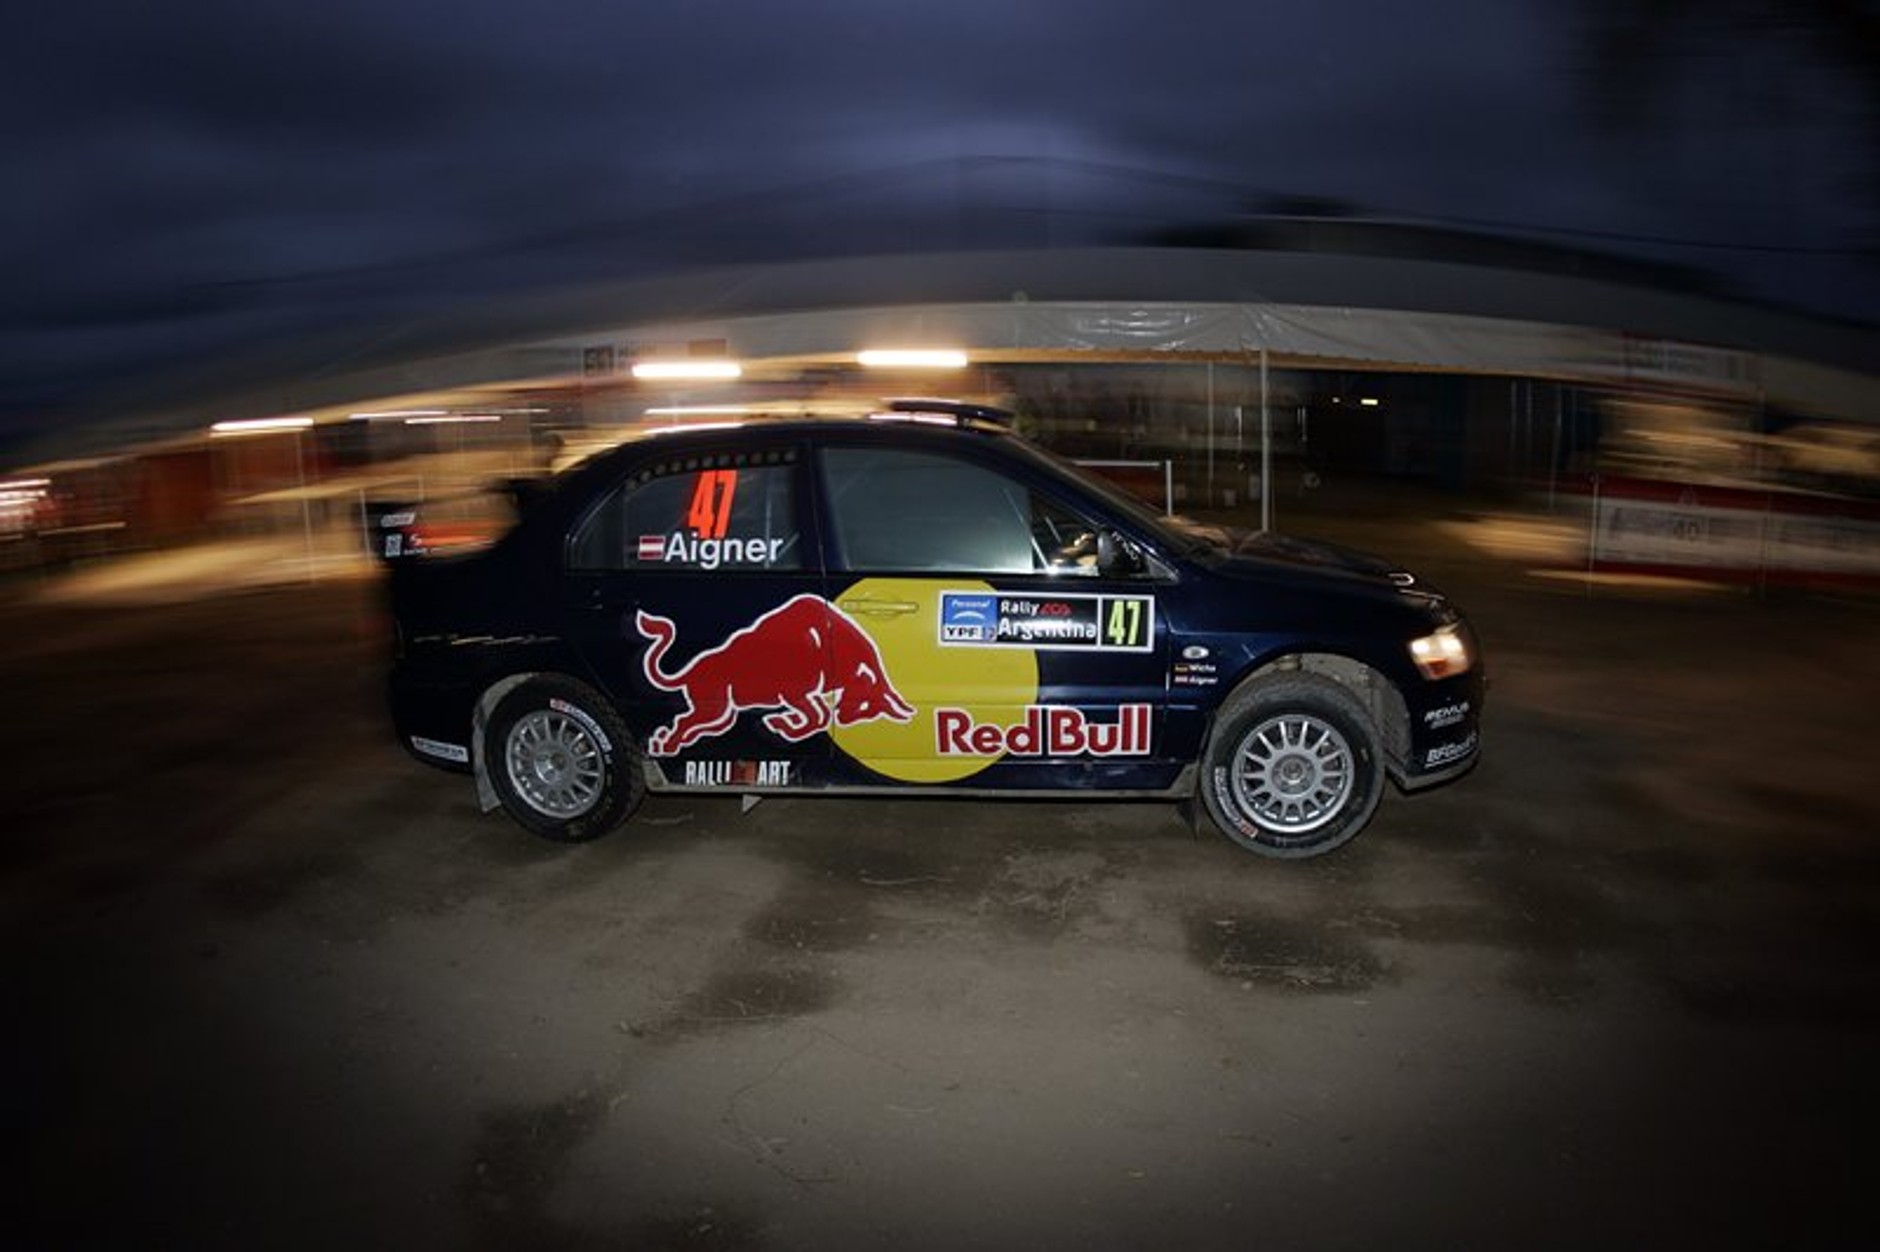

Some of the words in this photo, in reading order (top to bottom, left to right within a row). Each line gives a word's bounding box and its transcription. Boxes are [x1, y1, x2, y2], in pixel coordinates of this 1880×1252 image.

[688, 469, 738, 540] 47
[664, 532, 784, 570] Aigner
[1000, 600, 1040, 616] Rally
[1107, 600, 1142, 645] 47
[998, 618, 1097, 640] Argentina
[934, 705, 1042, 755] Red
[1048, 704, 1152, 755] Bull
